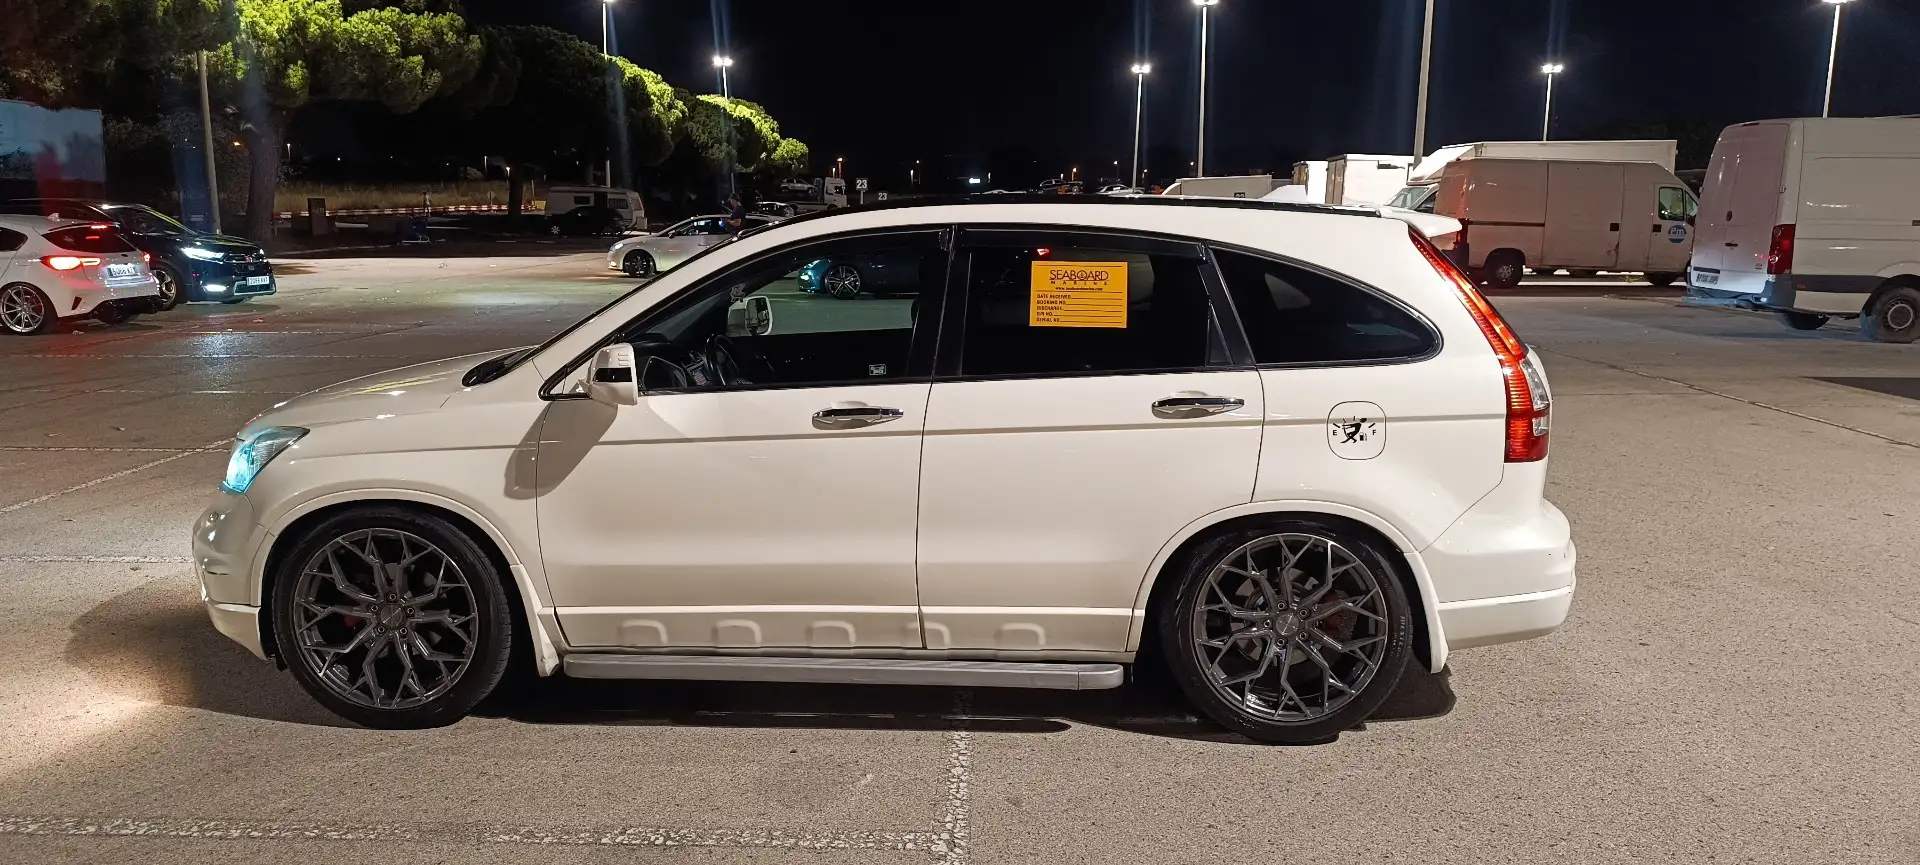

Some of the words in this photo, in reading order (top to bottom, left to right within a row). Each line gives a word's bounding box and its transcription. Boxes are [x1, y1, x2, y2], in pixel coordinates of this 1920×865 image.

[857, 179, 867, 189] 23
[878, 192, 887, 200] 23
[1049, 269, 1109, 280] SEABOARD
